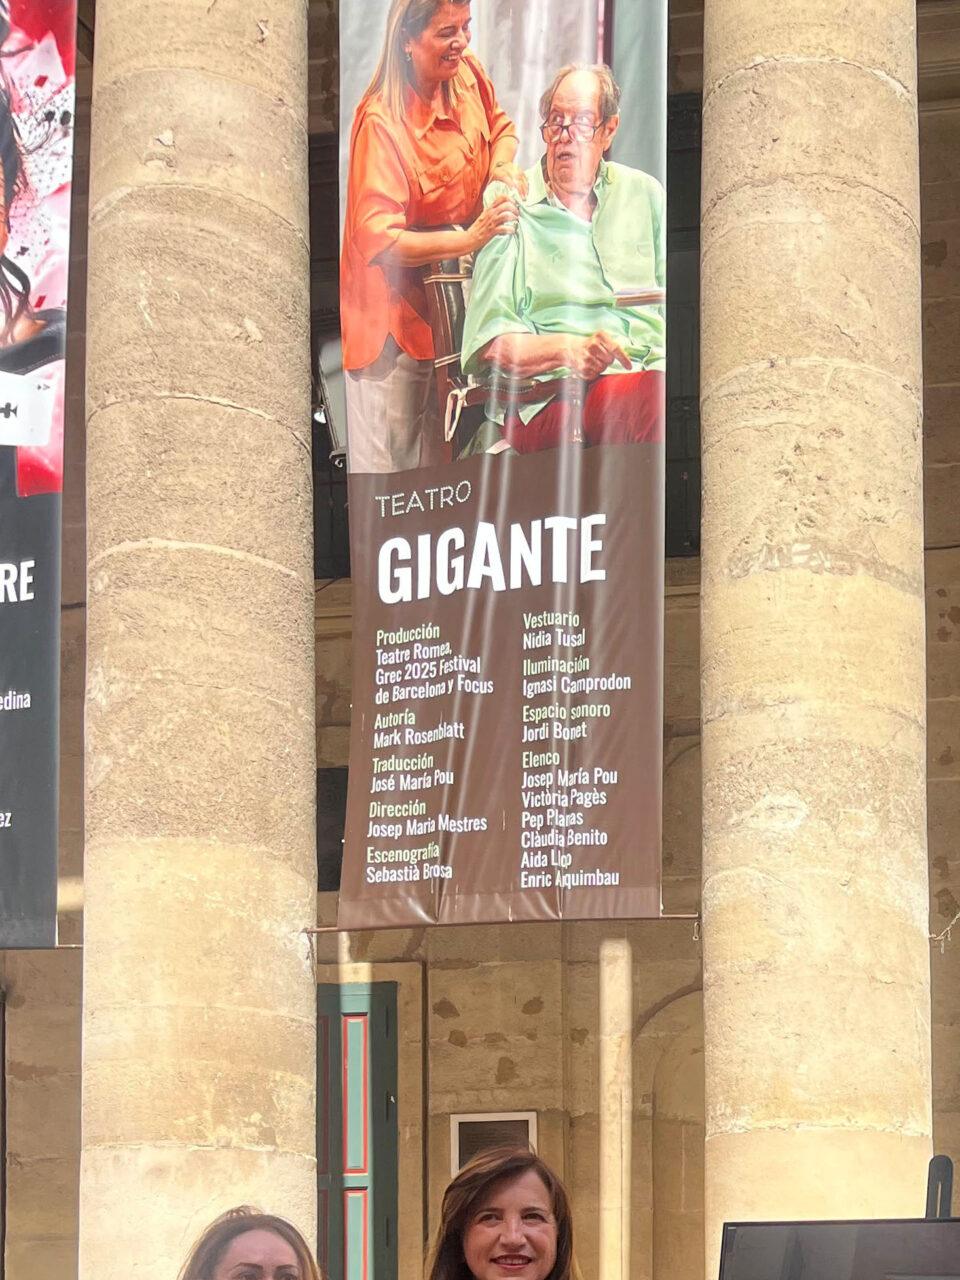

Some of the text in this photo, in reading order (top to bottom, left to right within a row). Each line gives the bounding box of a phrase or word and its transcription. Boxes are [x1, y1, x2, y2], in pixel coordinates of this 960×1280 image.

[375, 480, 472, 517] TEATRO
[378, 513, 606, 604] GIGANTE
[523, 611, 580, 630] Vestuario
[376, 622, 440, 646] Producción
[555, 628, 586, 648] Tusal
[376, 642, 452, 666] Teatre Romea,
[375, 655, 481, 685] Grec 2025 Festival
[523, 655, 590, 676] Iluminación
[375, 674, 494, 704] de Barcelona y Focus
[523, 673, 631, 699] Ignasi Camprodon
[374, 708, 416, 730] Autoría
[522, 702, 611, 724] Espacio sonoro
[373, 722, 465, 749] Mark Rosenblatt
[522, 721, 587, 743] Jordi Bonet
[372, 752, 434, 774] Traducción
[522, 751, 560, 769] Elenco
[370, 769, 454, 794] José María Pou
[521, 767, 618, 789] Josep María Pou
[369, 799, 427, 818] Dirección
[521, 788, 607, 808] Victòria Pagès
[367, 821, 402, 840] Josep
[438, 814, 488, 833] Mestres
[521, 811, 544, 830] Pep
[521, 828, 608, 848] Clàudia Benito
[366, 841, 440, 864] Escenografía
[521, 850, 548, 868] Aida
[366, 863, 453, 884] Sebastià Brosa
[521, 872, 552, 888] Enric
